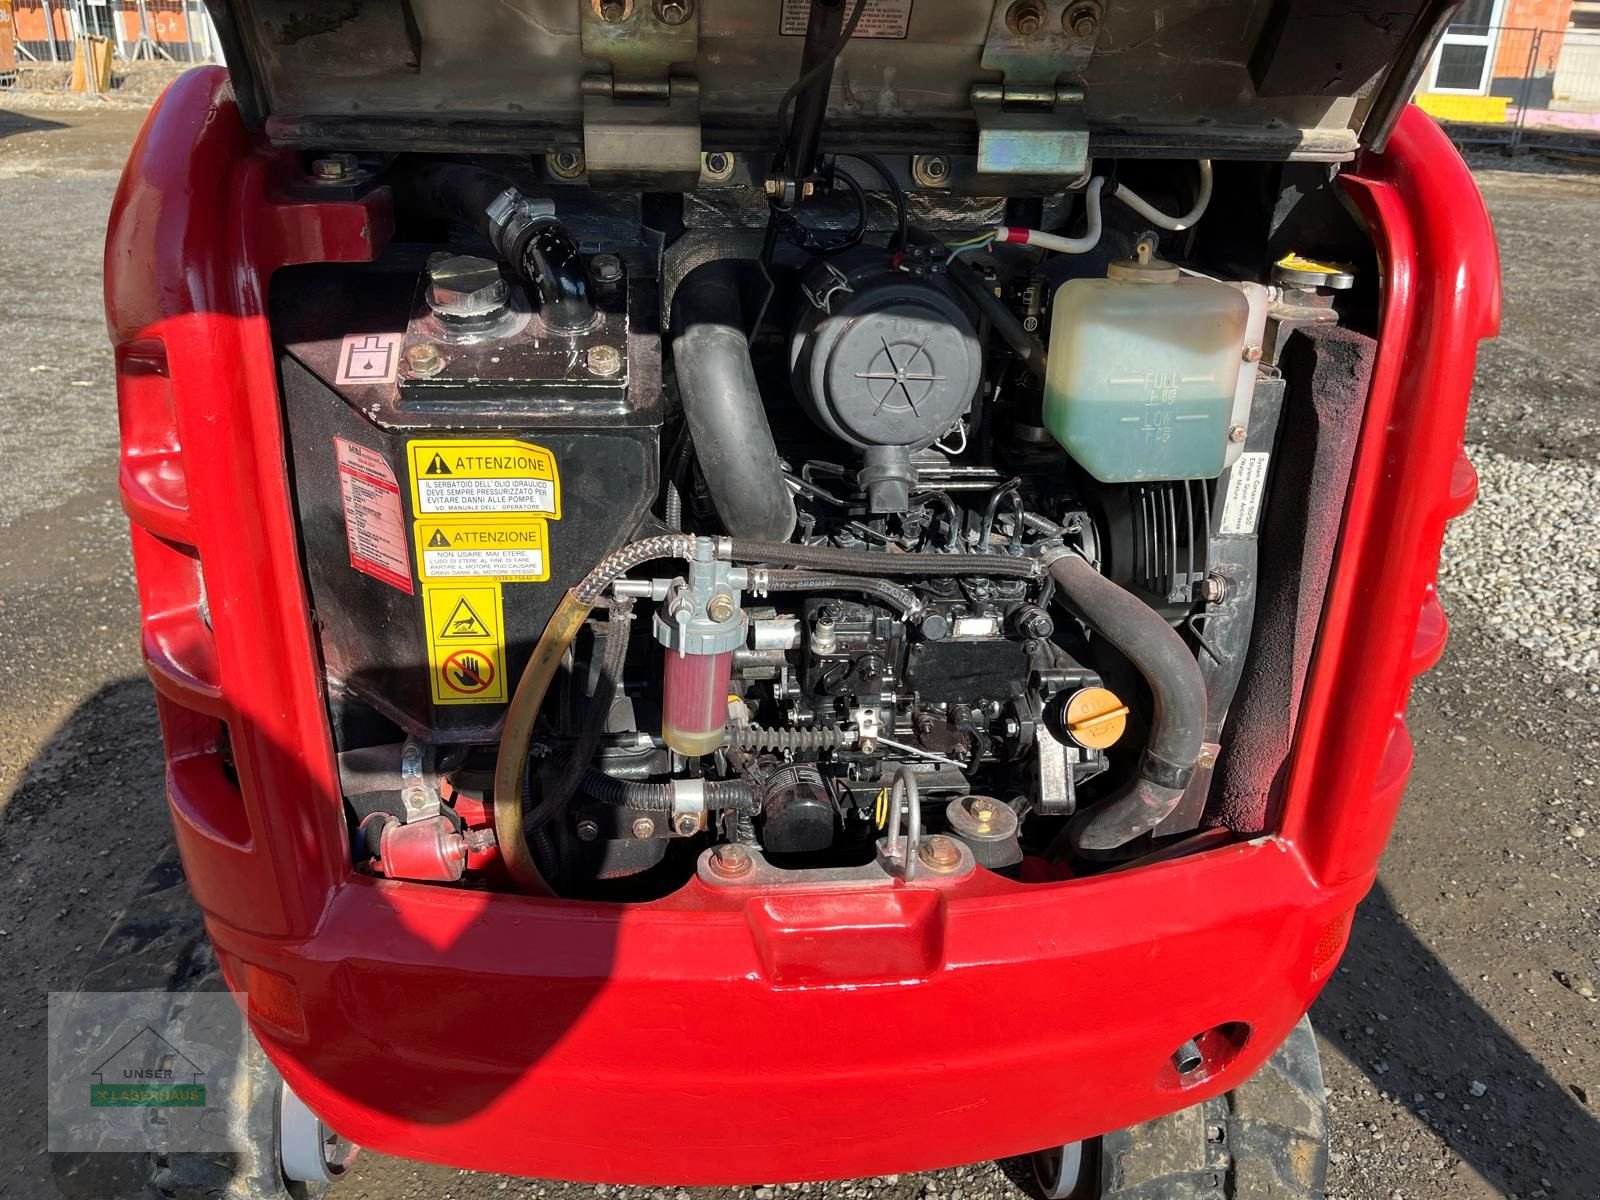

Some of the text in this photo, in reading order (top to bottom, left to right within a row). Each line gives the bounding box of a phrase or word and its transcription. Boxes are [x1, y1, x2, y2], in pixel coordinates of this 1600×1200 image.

[1144, 372, 1180, 392] FULL
[1144, 410, 1173, 428] LOW
[456, 457, 545, 471] ATTENZIONE
[1246, 457, 1256, 481] Ethylene
[1256, 457, 1264, 477] System
[512, 481, 547, 489] IDRAULICO
[1233, 479, 1243, 500] Mixture
[1249, 480, 1260, 504] Contains
[1236, 503, 1246, 529] Antifreeze
[454, 532, 537, 543] ATTENZIONE
